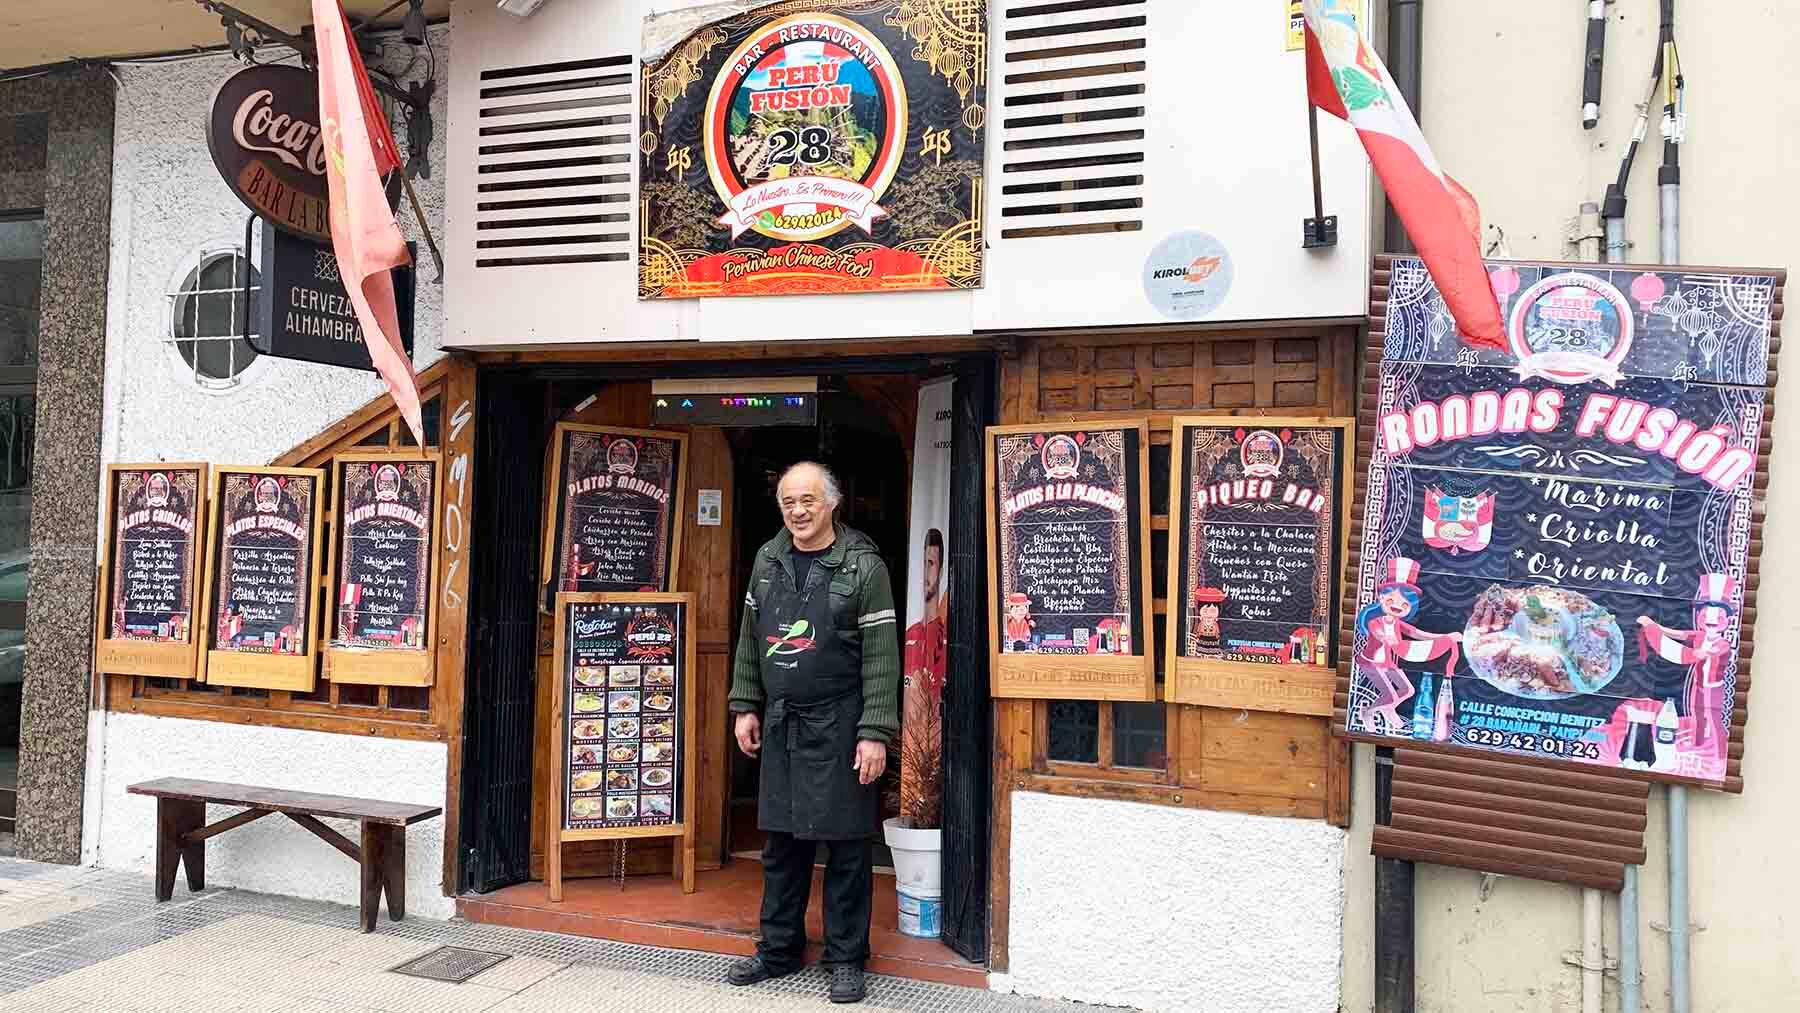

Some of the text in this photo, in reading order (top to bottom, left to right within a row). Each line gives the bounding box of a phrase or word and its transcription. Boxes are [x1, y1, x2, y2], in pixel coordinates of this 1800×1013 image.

[735, 24, 882, 76] BAR RESTAURANT
[768, 57, 840, 87] PERÚ
[750, 83, 851, 112] FUSIÓN
[768, 126, 833, 167] 28
[248, 167, 283, 217] BAR
[288, 191, 306, 228] LA
[775, 207, 842, 229] 629420124
[722, 246, 873, 281] Peruvian Chinese Food
[286, 311, 363, 344] ALHAMBRA
[1549, 328, 1586, 347] 28
[1381, 388, 1757, 490] RONDAS FUSIÓN
[568, 475, 670, 504] PLATOS MARINOS
[1004, 486, 1045, 515] PLATOS
[1045, 488, 1055, 501] A
[1056, 484, 1072, 500] LA
[1197, 479, 1326, 513] PIQUEO BAR
[1544, 480, 1665, 512] Marina
[118, 509, 151, 533] PLATOS
[345, 504, 376, 527] PLATOS
[226, 516, 307, 541] PLATOS ESPECIALES
[1079, 533, 1097, 543] Mix
[1261, 528, 1270, 538] la
[1275, 527, 1316, 540] Chalaca
[1540, 512, 1662, 548] Criolla
[1078, 552, 1113, 564] Especial
[1206, 539, 1237, 552] Alitas
[1253, 541, 1262, 551] la
[1268, 541, 1316, 554] Mexicana
[1076, 564, 1108, 574] Patatas
[1276, 556, 1308, 573] Queso
[1527, 553, 1669, 586] Oriental
[1027, 586, 1047, 595] Pollo
[1073, 586, 1105, 595] Plancha
[1032, 575, 1099, 586] Salchipapa Mix
[1282, 586, 1292, 596] la
[627, 630, 656, 642] PERÚ
[1227, 653, 1242, 661] 629
[1271, 656, 1282, 664] 24
[1459, 701, 1494, 716] CALLE
[1467, 728, 1599, 758] 629 42 01 24
